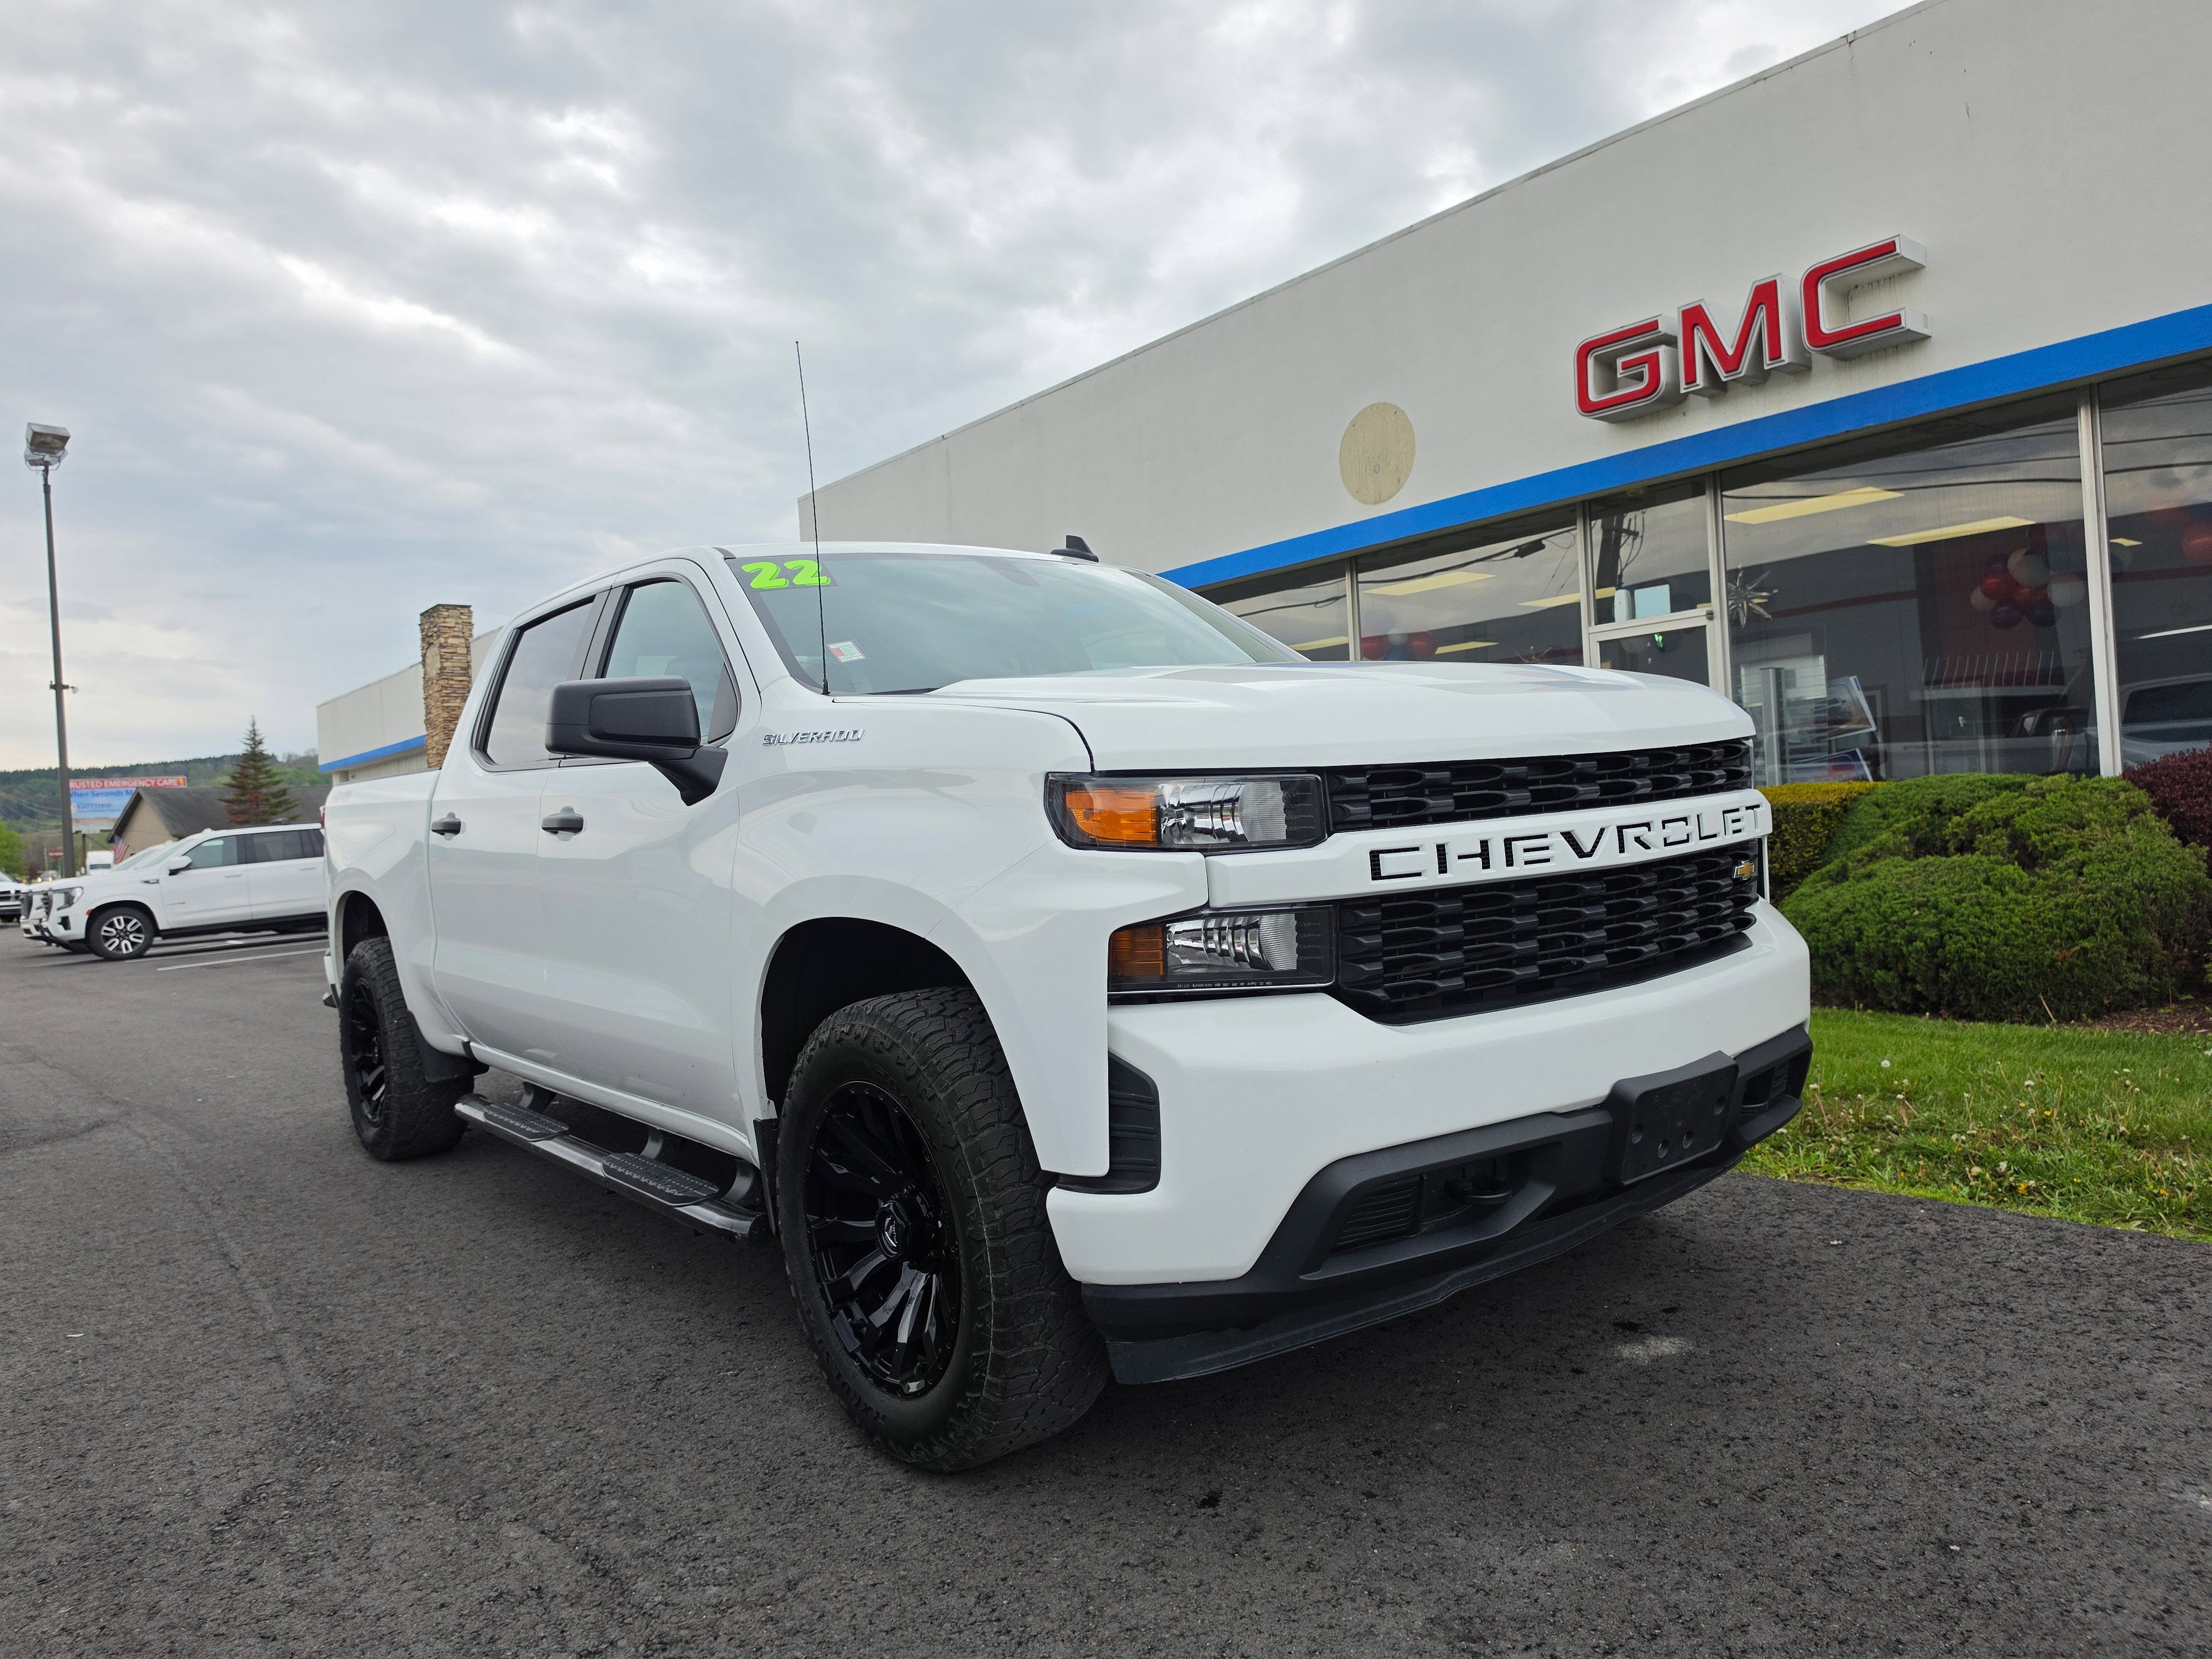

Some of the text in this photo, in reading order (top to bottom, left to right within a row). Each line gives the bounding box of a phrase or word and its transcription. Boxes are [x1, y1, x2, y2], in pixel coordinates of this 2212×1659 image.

[1574, 234, 1913, 419] GMC
[741, 559, 831, 589] 22
[762, 728, 865, 747] SILVERADO
[70, 778, 179, 790] RUSTED EMERGENCY CARE
[1368, 802, 1766, 881] CHEVROLET
